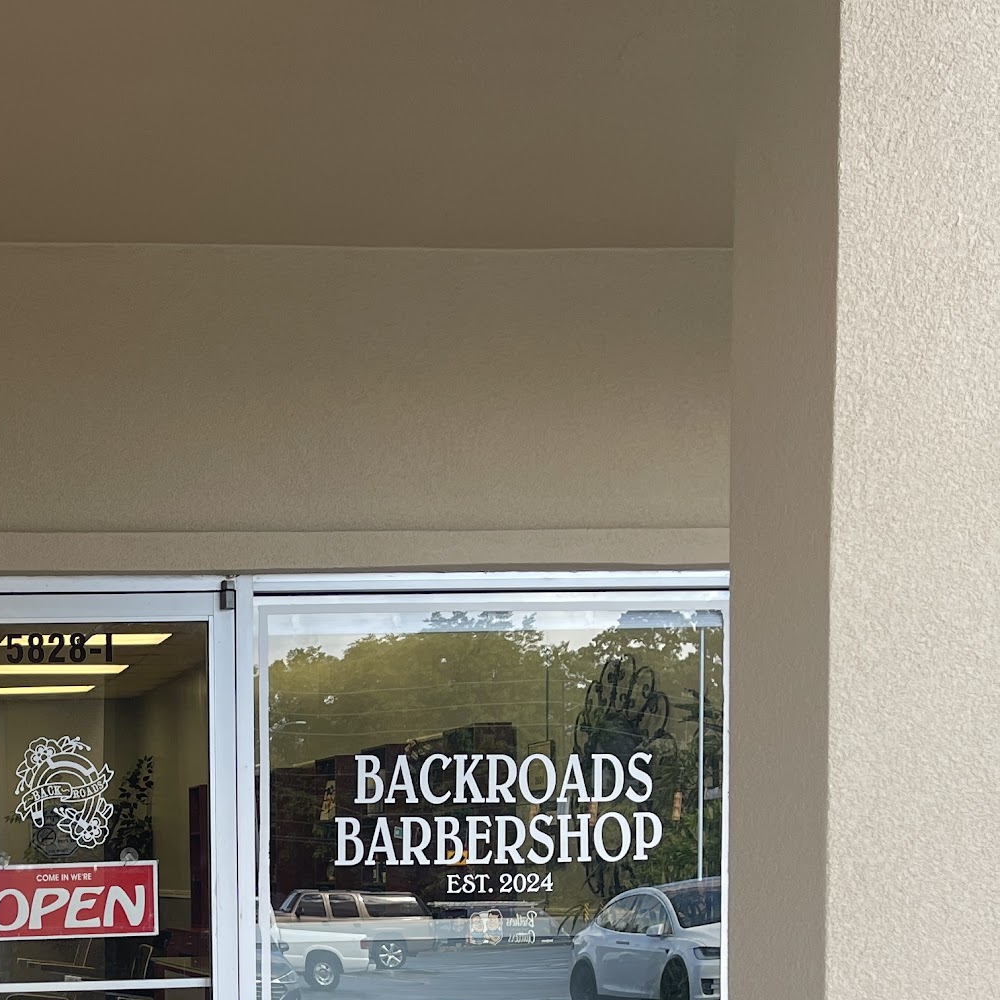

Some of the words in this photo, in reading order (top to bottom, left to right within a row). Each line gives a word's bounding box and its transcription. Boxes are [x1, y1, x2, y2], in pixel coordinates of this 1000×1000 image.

[354, 751, 653, 805] BACKROADS
[31, 785, 62, 802] BACK
[72, 780, 105, 799] ROADS
[334, 811, 663, 867] BARBERSHOP
[36, 873, 60, 882] COME
[61, 873, 69, 882] IN
[70, 872, 92, 881] WE'RE
[446, 874, 494, 894] EST.
[499, 872, 554, 893] 2024
